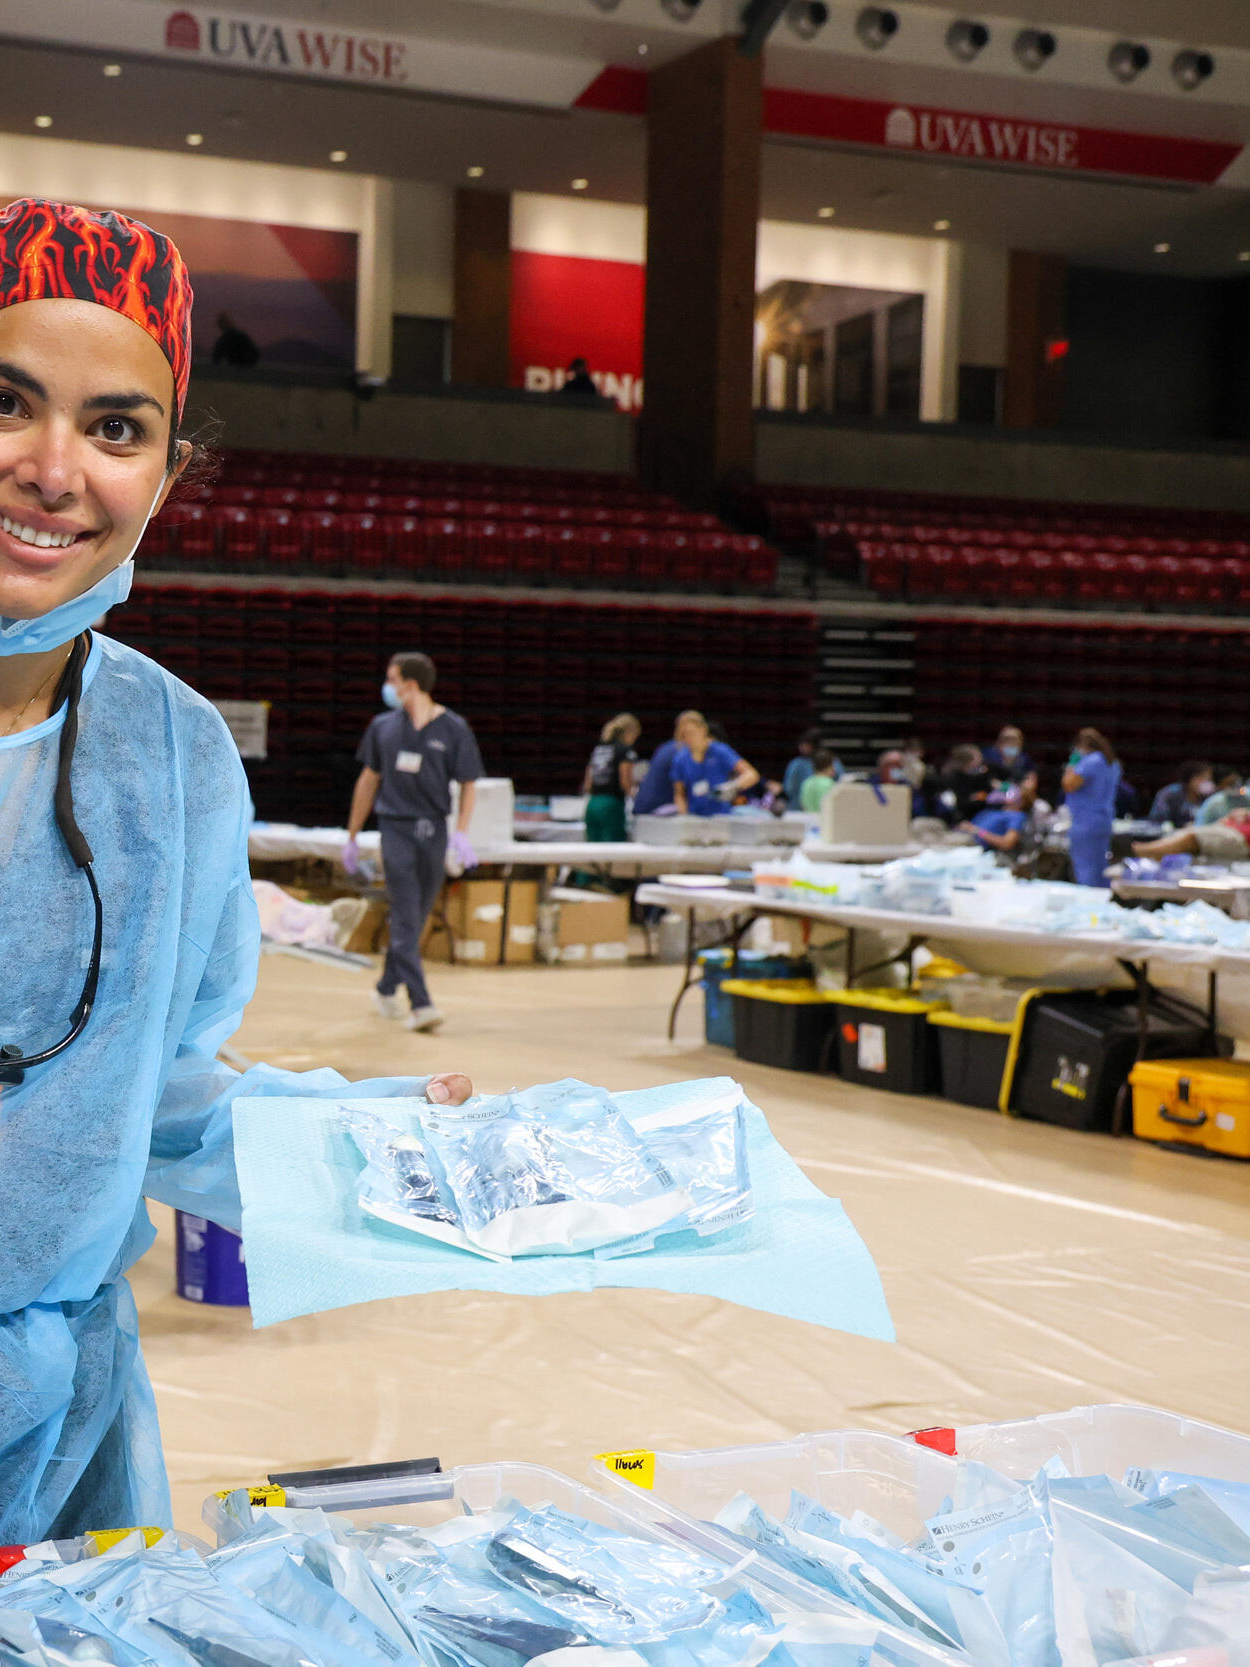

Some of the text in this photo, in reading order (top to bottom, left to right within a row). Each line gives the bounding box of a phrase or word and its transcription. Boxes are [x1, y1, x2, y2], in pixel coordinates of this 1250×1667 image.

[208, 17, 408, 81] UVA WISE
[919, 113, 1079, 167] UVA WISE
